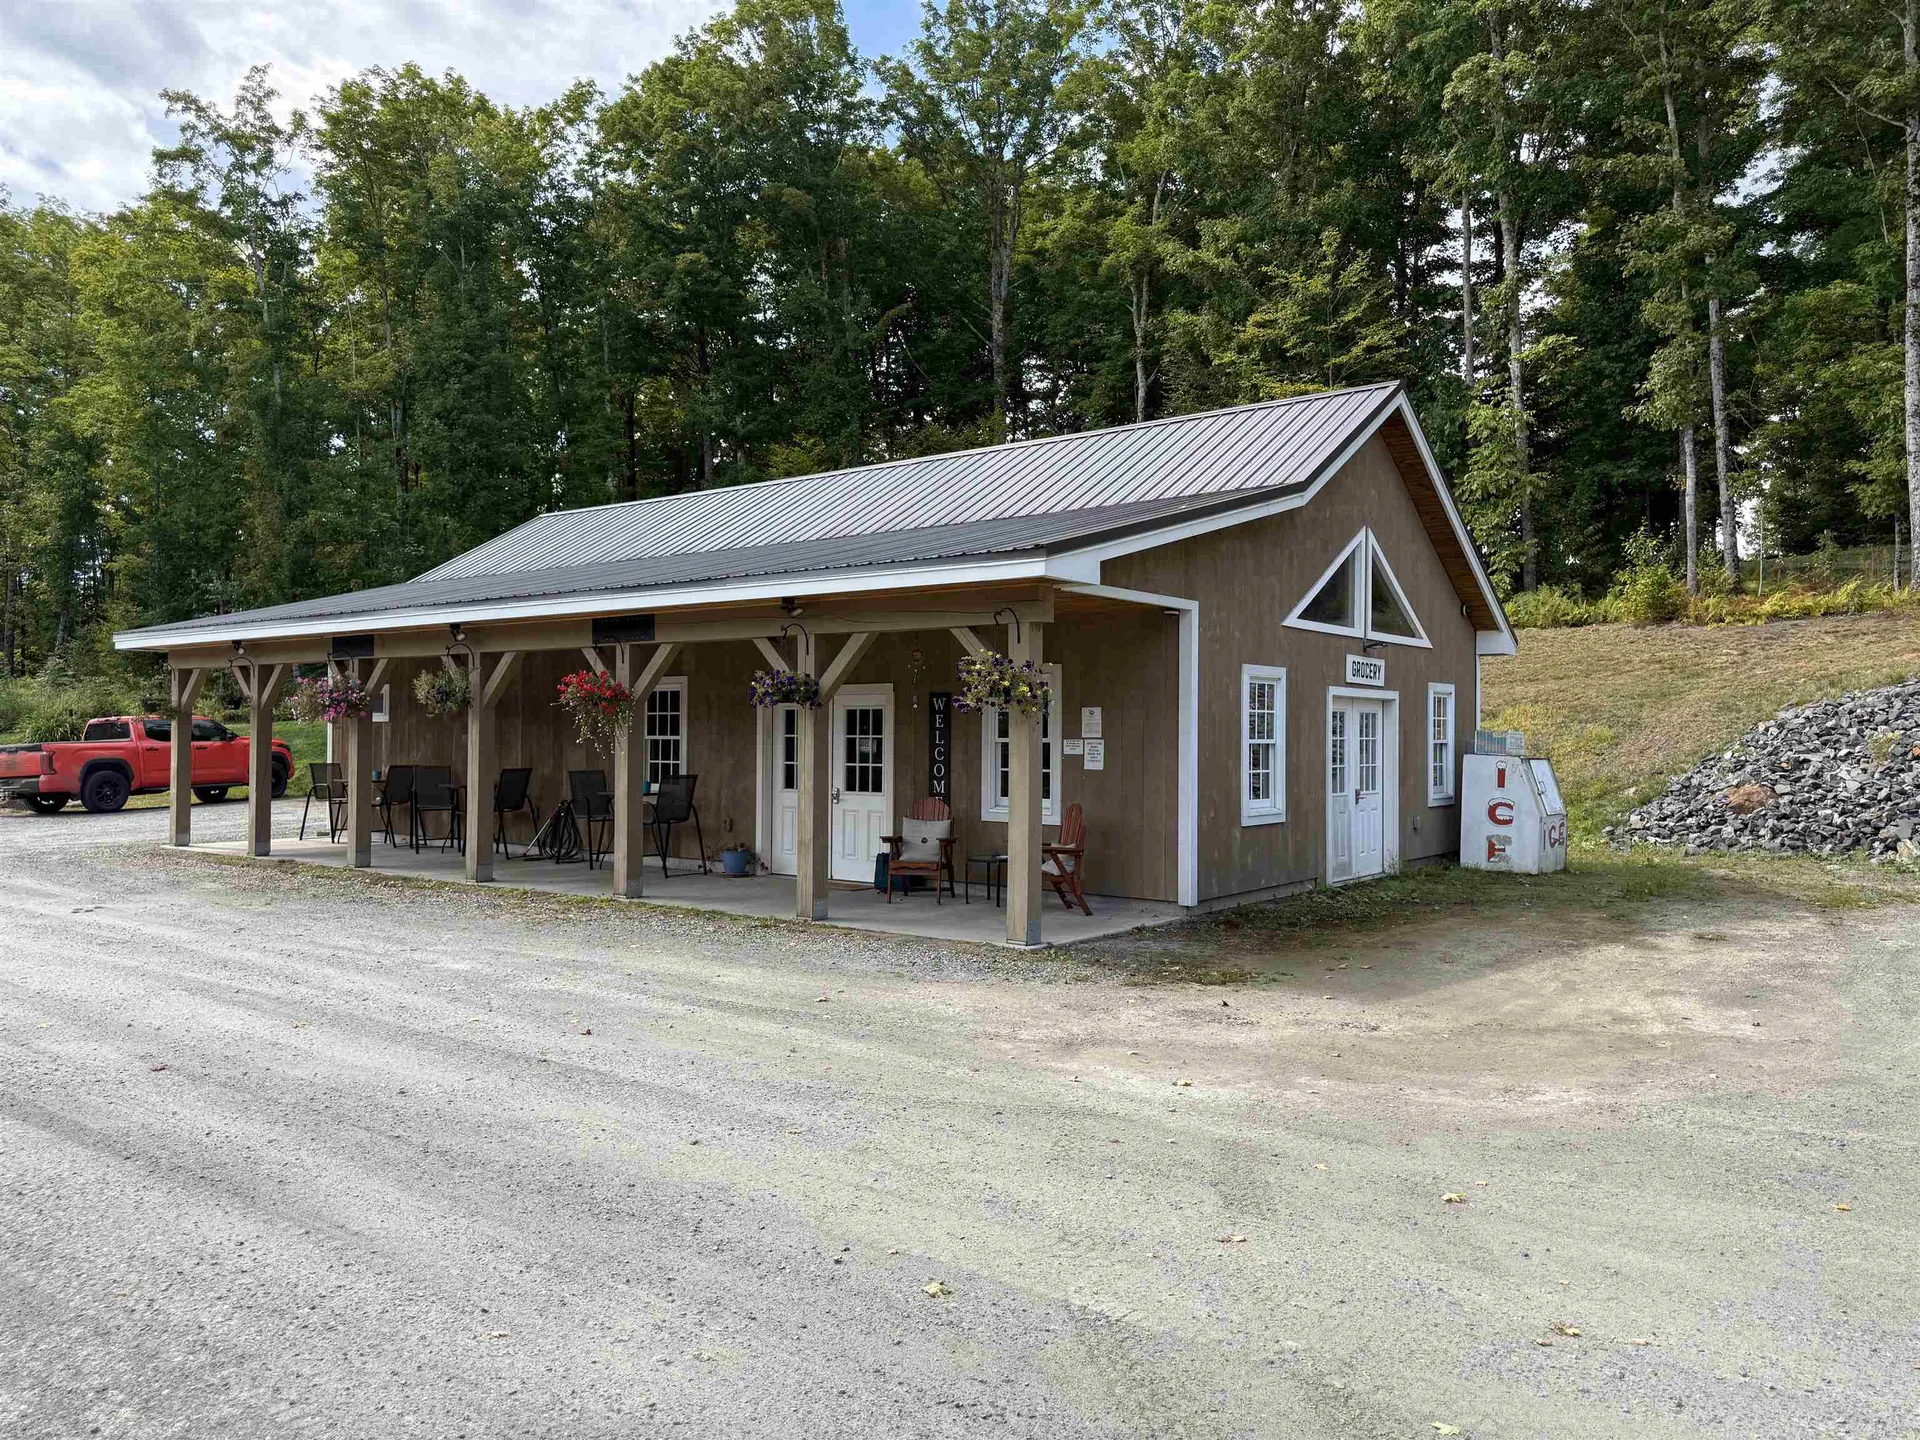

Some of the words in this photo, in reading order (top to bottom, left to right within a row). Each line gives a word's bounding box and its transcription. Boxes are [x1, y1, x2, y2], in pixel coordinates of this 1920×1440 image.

[1352, 660, 1382, 680] GROCERY
[932, 697, 947, 800] WELCOM
[1485, 760, 1515, 863] ICE
